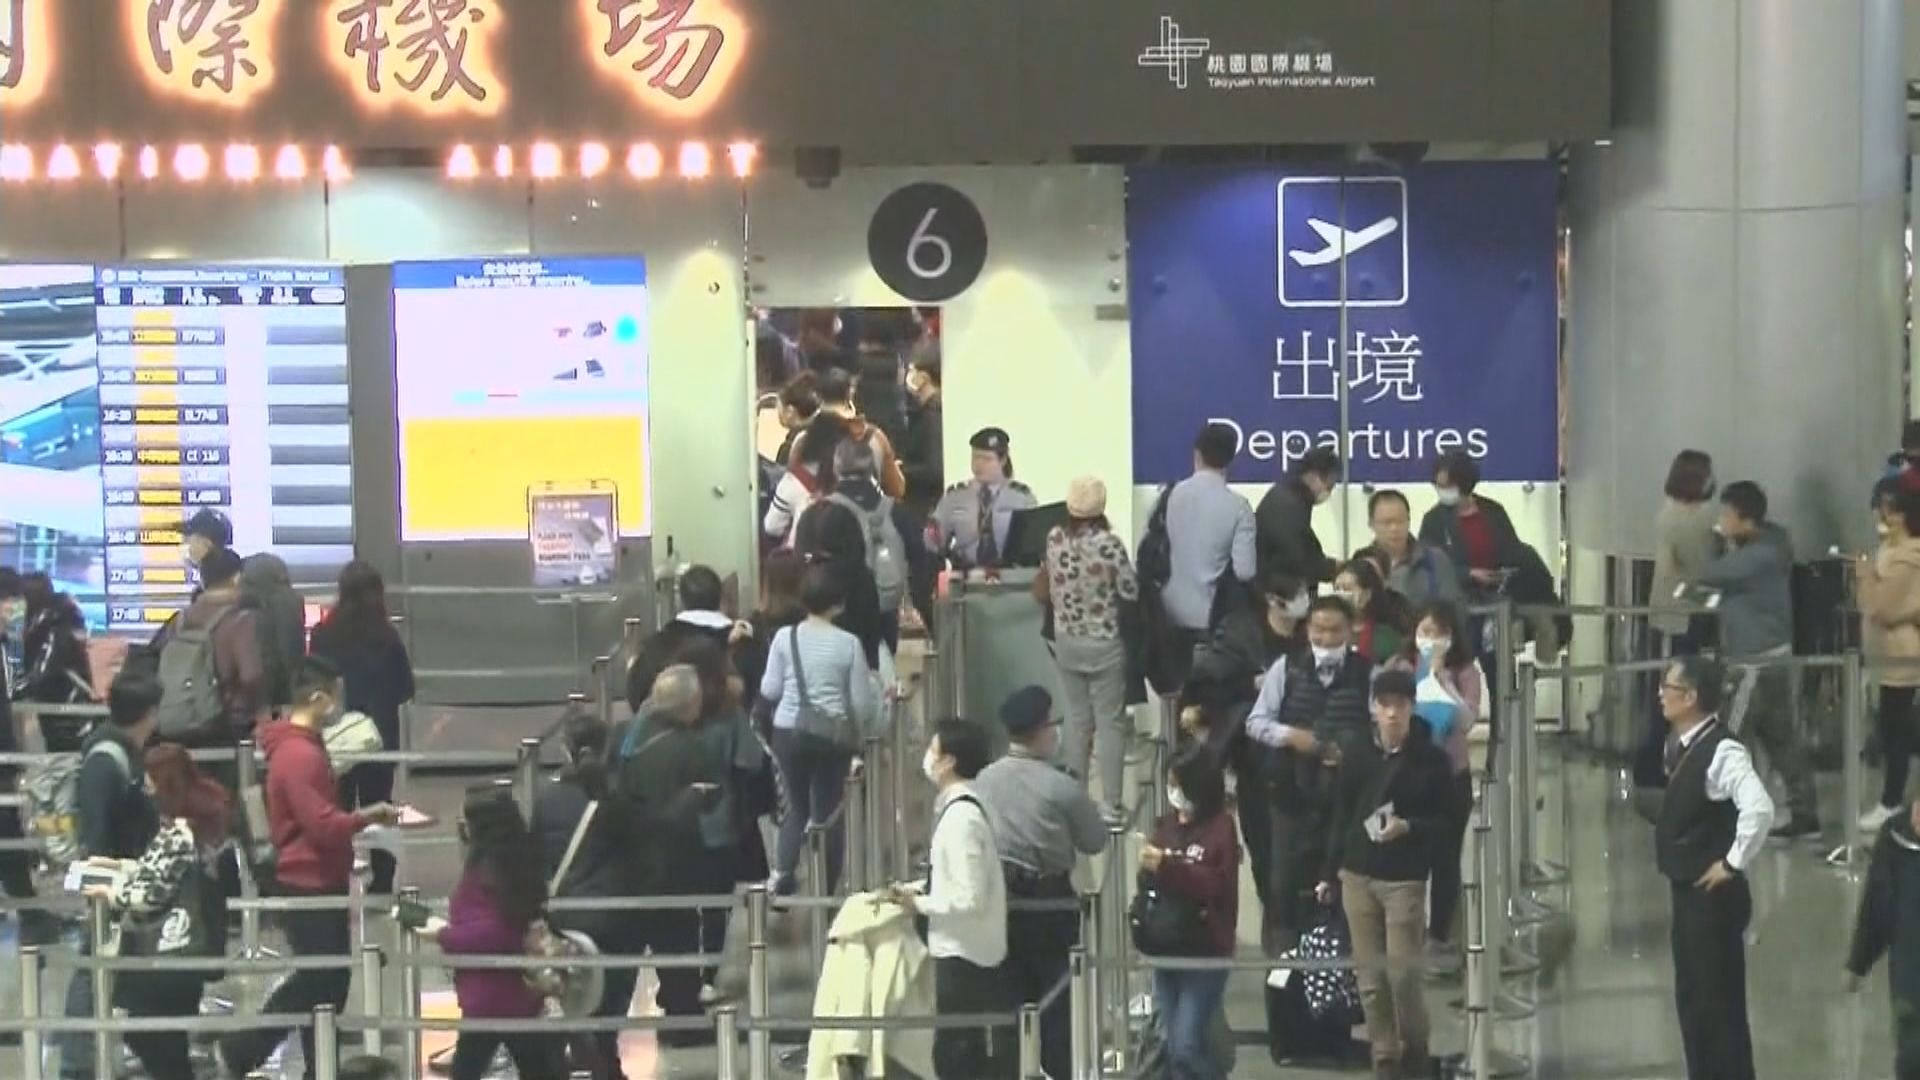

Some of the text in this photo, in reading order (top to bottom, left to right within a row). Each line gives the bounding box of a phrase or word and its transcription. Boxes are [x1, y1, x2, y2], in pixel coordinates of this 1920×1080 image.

[1208, 75, 1376, 89] Taoyuan International Airport
[446, 141, 758, 179] AIRPORT
[906, 207, 952, 280] 6
[1272, 330, 1425, 403] 出境
